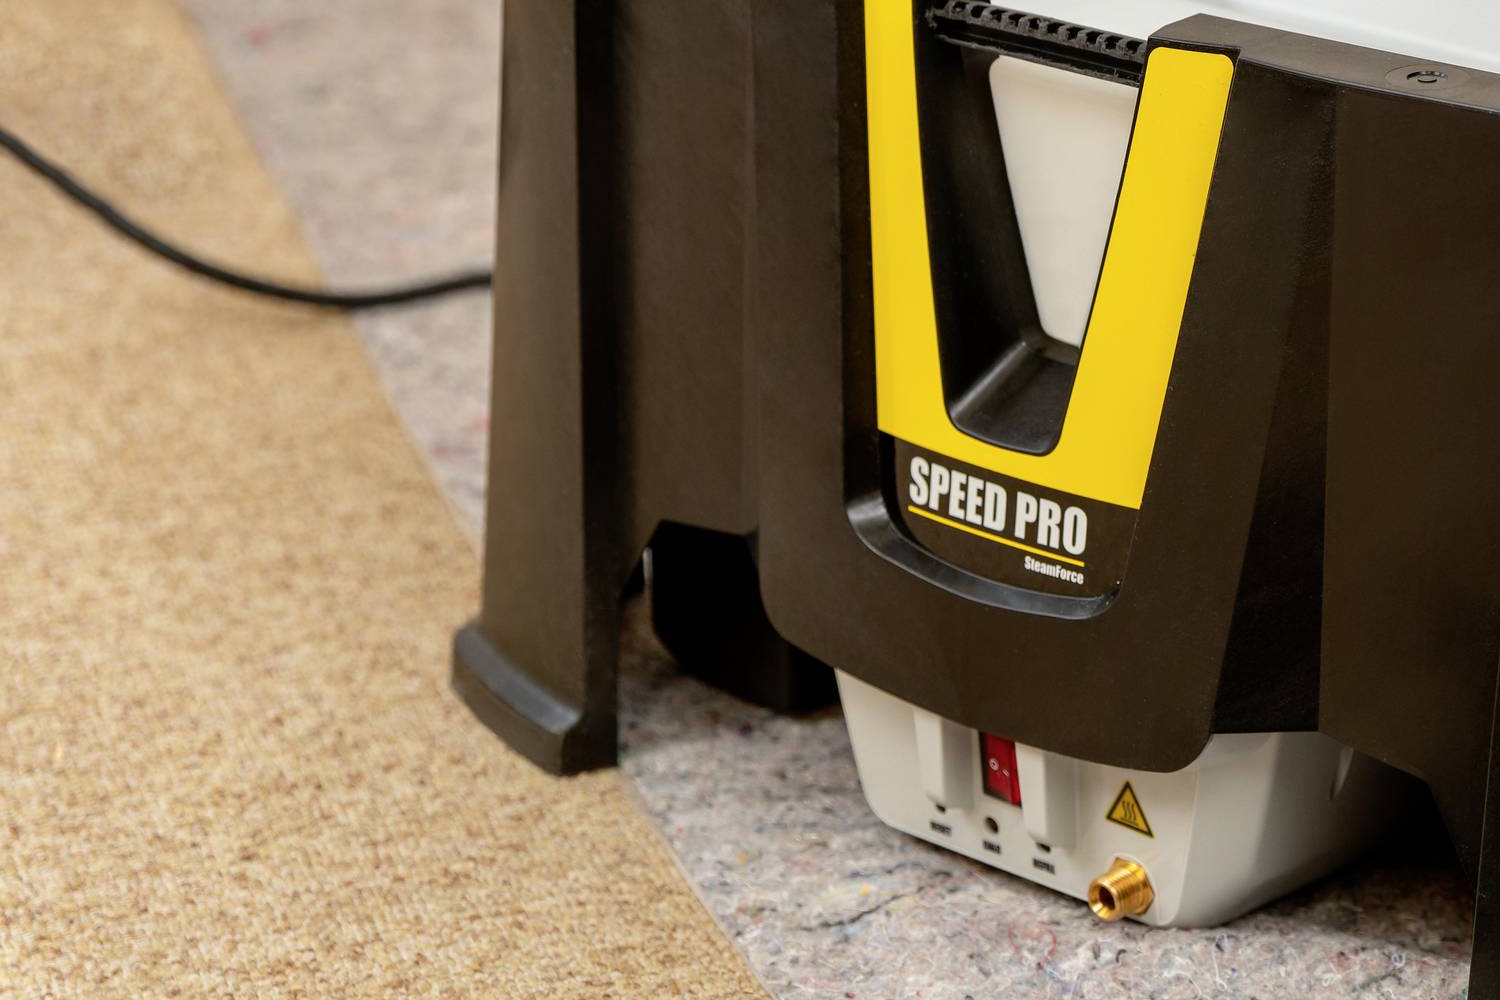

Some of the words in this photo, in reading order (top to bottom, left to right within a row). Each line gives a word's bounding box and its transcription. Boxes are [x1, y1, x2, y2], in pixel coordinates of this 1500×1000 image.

[909, 456, 1007, 532] SPEED
[1014, 490, 1088, 555] PRO
[1024, 555, 1084, 584] SteamForce
